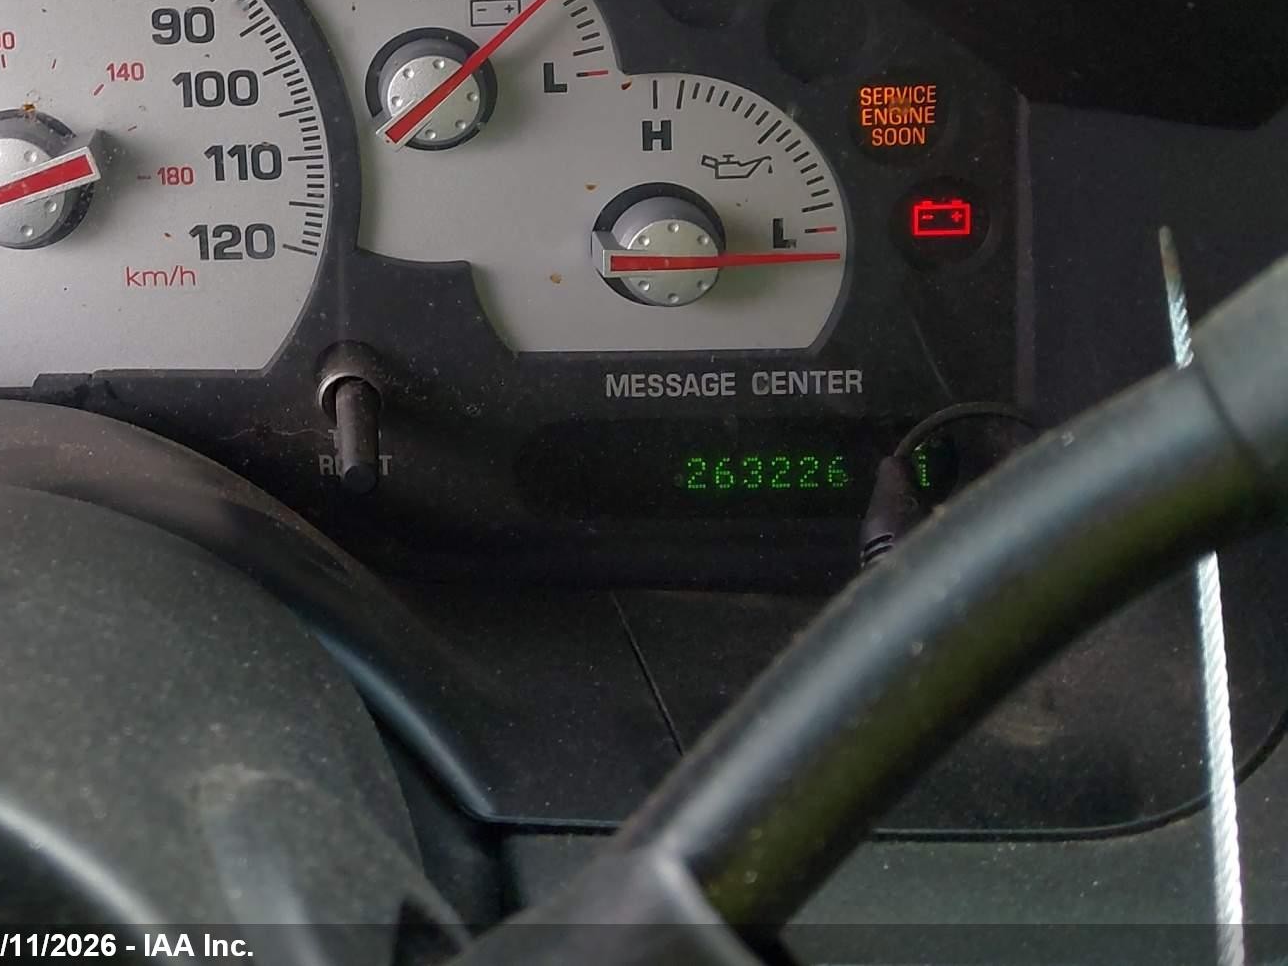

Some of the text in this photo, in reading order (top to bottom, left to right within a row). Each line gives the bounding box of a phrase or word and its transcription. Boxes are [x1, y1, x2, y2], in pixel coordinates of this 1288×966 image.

[151, 6, 215, 45] 90
[107, 63, 144, 81] 140
[544, 63, 567, 93] L
[172, 70, 259, 107] 100
[860, 86, 937, 105] SERVICE
[861, 106, 935, 126] ENGINE
[642, 120, 672, 151] H
[871, 127, 926, 147] SOON
[157, 167, 194, 185] 180
[204, 144, 282, 181] 110
[188, 224, 275, 260] 120
[772, 219, 795, 249] L
[125, 266, 196, 288] km/h
[605, 370, 863, 397] MESSAGE CENTER
[687, 456, 848, 489] 263226
